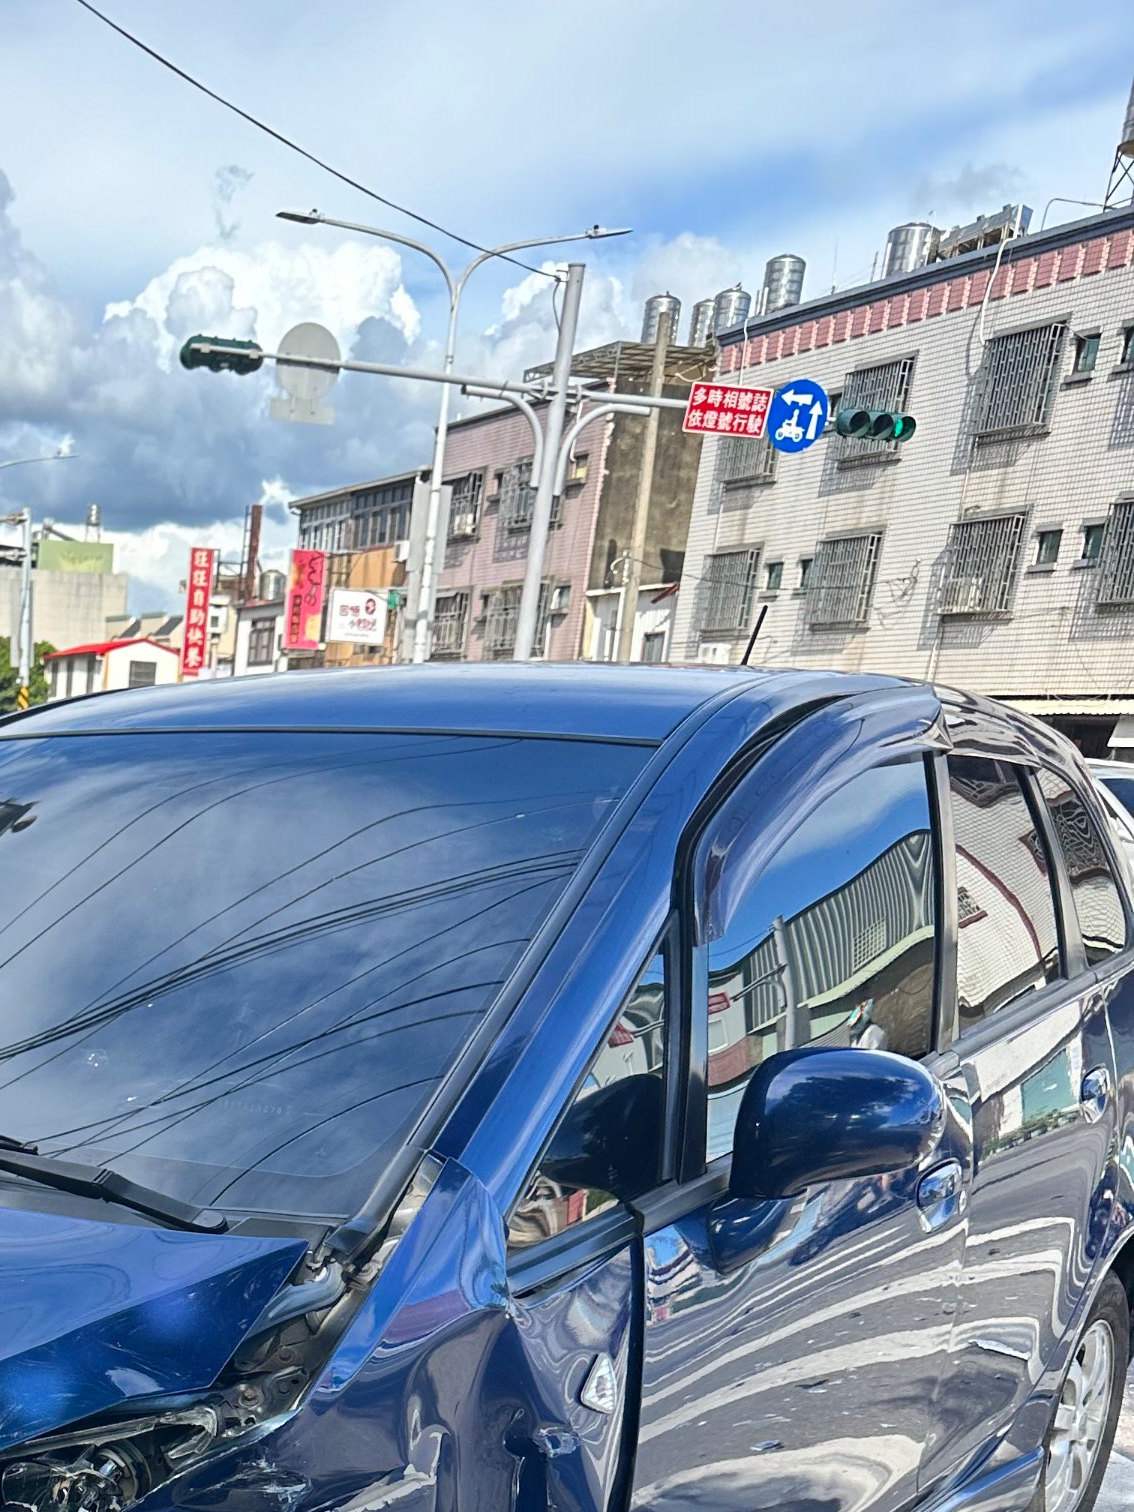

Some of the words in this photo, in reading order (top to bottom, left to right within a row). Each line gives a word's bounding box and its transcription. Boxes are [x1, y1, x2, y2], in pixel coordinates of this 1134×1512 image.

[692, 387, 768, 412] 多時相號誌
[687, 409, 763, 434] 依燈號行駛
